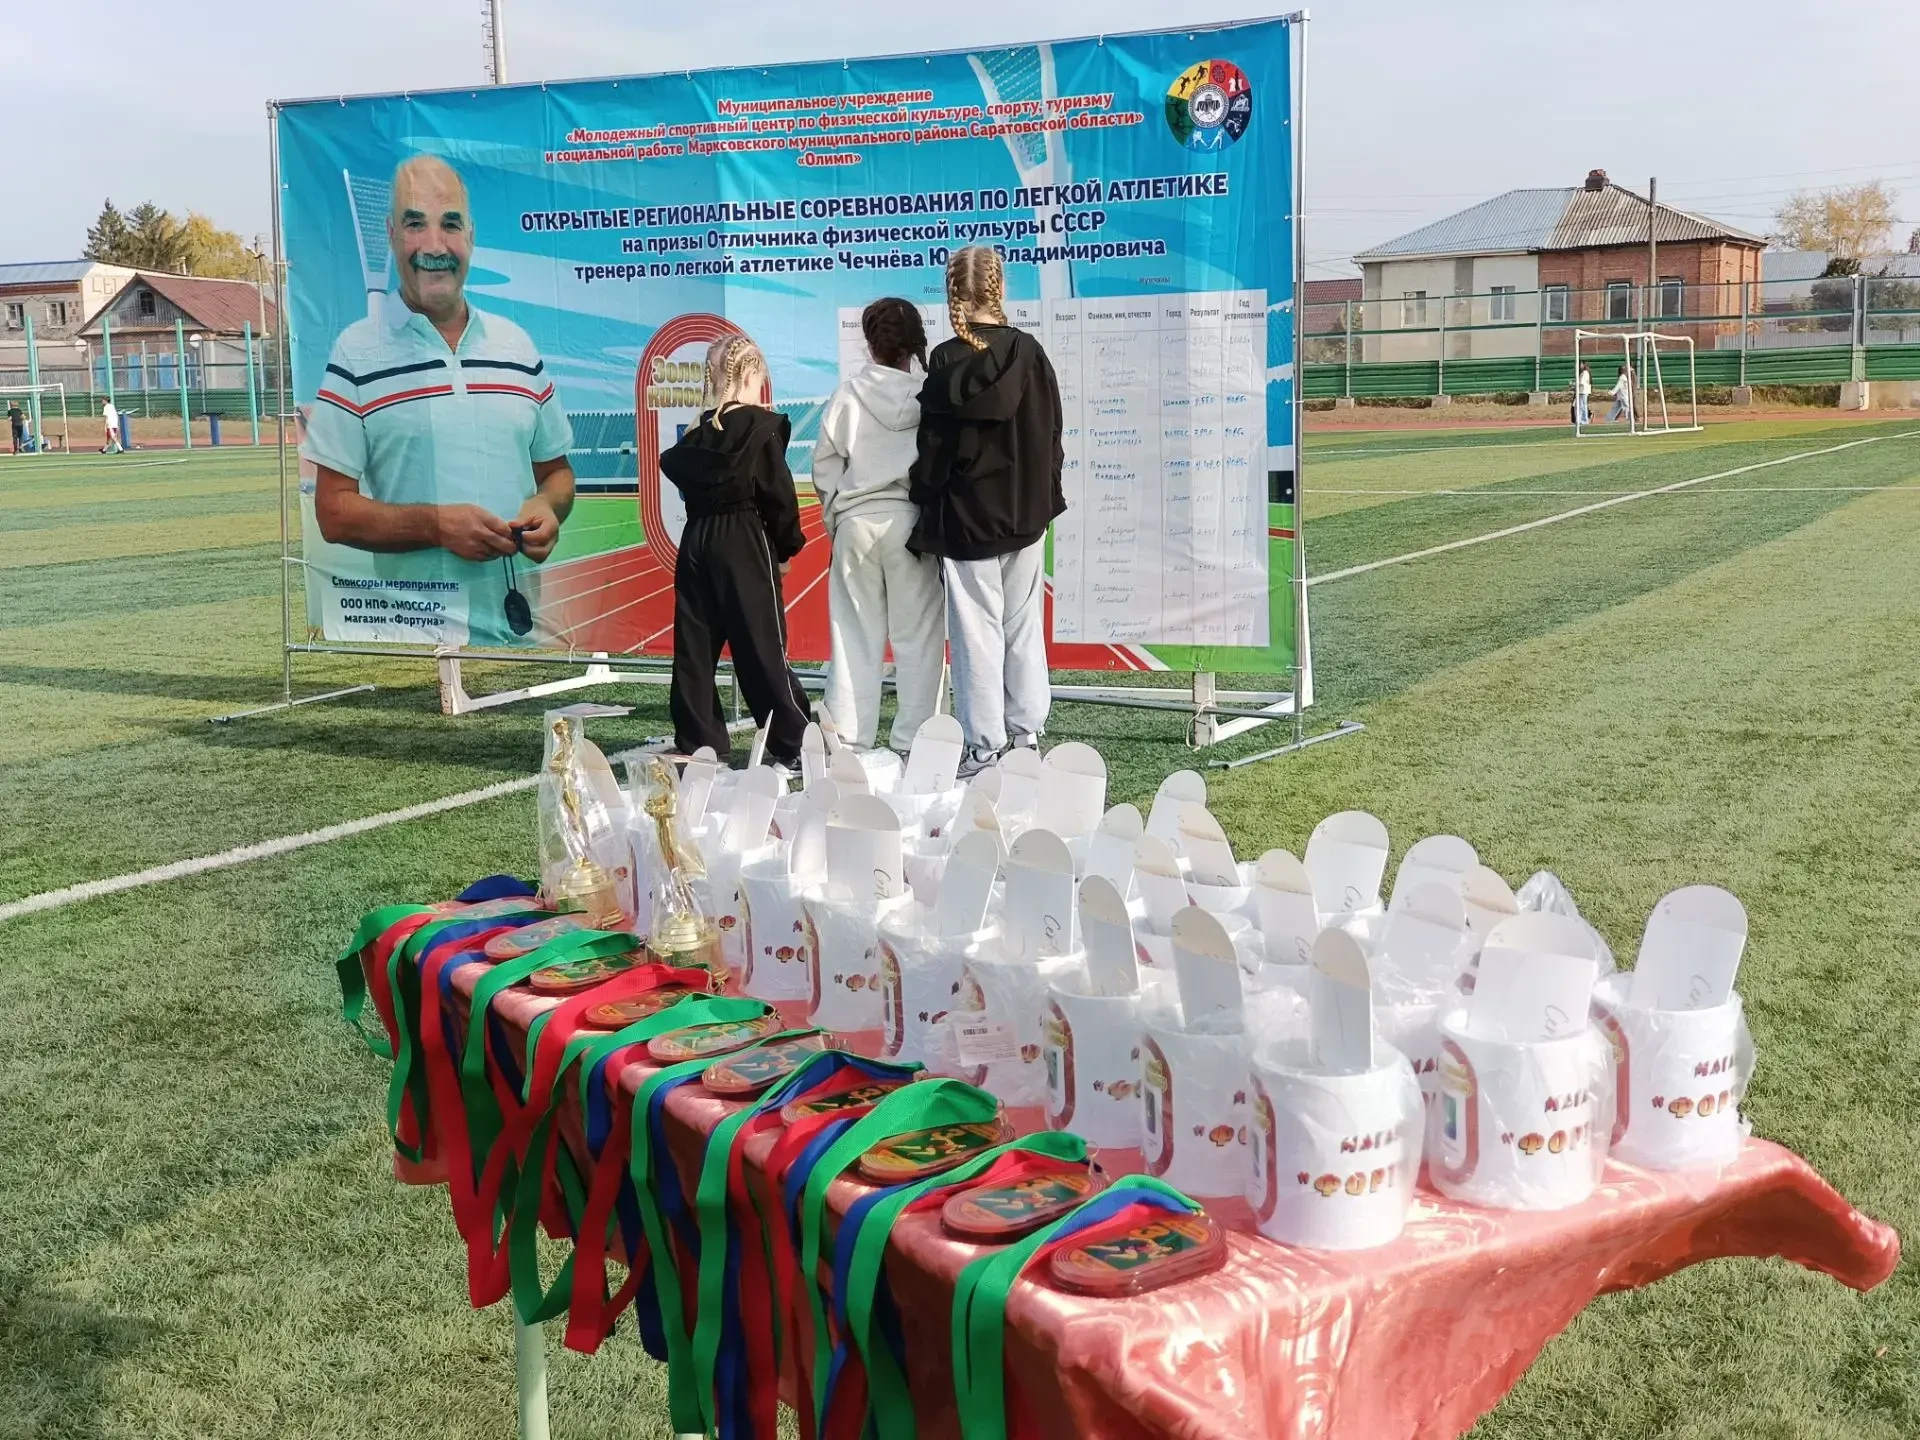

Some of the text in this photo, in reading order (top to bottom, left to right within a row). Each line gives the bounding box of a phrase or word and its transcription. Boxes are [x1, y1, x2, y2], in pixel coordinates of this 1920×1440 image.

[718, 91, 932, 115] Муниципальное учреждение
[567, 94, 1112, 143] «Молодежный спортивный центр по физической культуре, спорту, туризму
[546, 113, 1143, 162] и социальной работе Марксовского муниципального района Саратовской области»
[798, 152, 861, 166] «Олимп»
[521, 174, 1227, 231] ОТКРЫТЫЕ РЕГИОНАЛЬНЫЕ СОРЕВНОВАНИЯ ПО ЛЕГКОЙ АТЛЕТИКЕ
[623, 238, 642, 252] на
[648, 236, 703, 255] призы
[708, 230, 817, 250] Отличника
[823, 222, 949, 248] физической
[1051, 211, 1105, 233] СССР
[574, 263, 646, 283] тренера
[650, 263, 670, 277] по
[675, 257, 734, 276] легкой
[739, 256, 833, 273] атлетике
[838, 250, 924, 270] Чечнёва
[993, 239, 1165, 264] Владимировича
[1238, 299, 1249, 308] Год
[1127, 310, 1151, 319] отчество
[1165, 309, 1182, 318] Город
[1190, 308, 1220, 318] Результат
[1224, 312, 1265, 321] установления
[652, 356, 703, 383] Золо
[332, 576, 459, 591] Спонсоры мероприятия:
[340, 598, 446, 612] ООО НПФ «МОССАР»
[344, 614, 445, 628] магазин «Фортуна»
